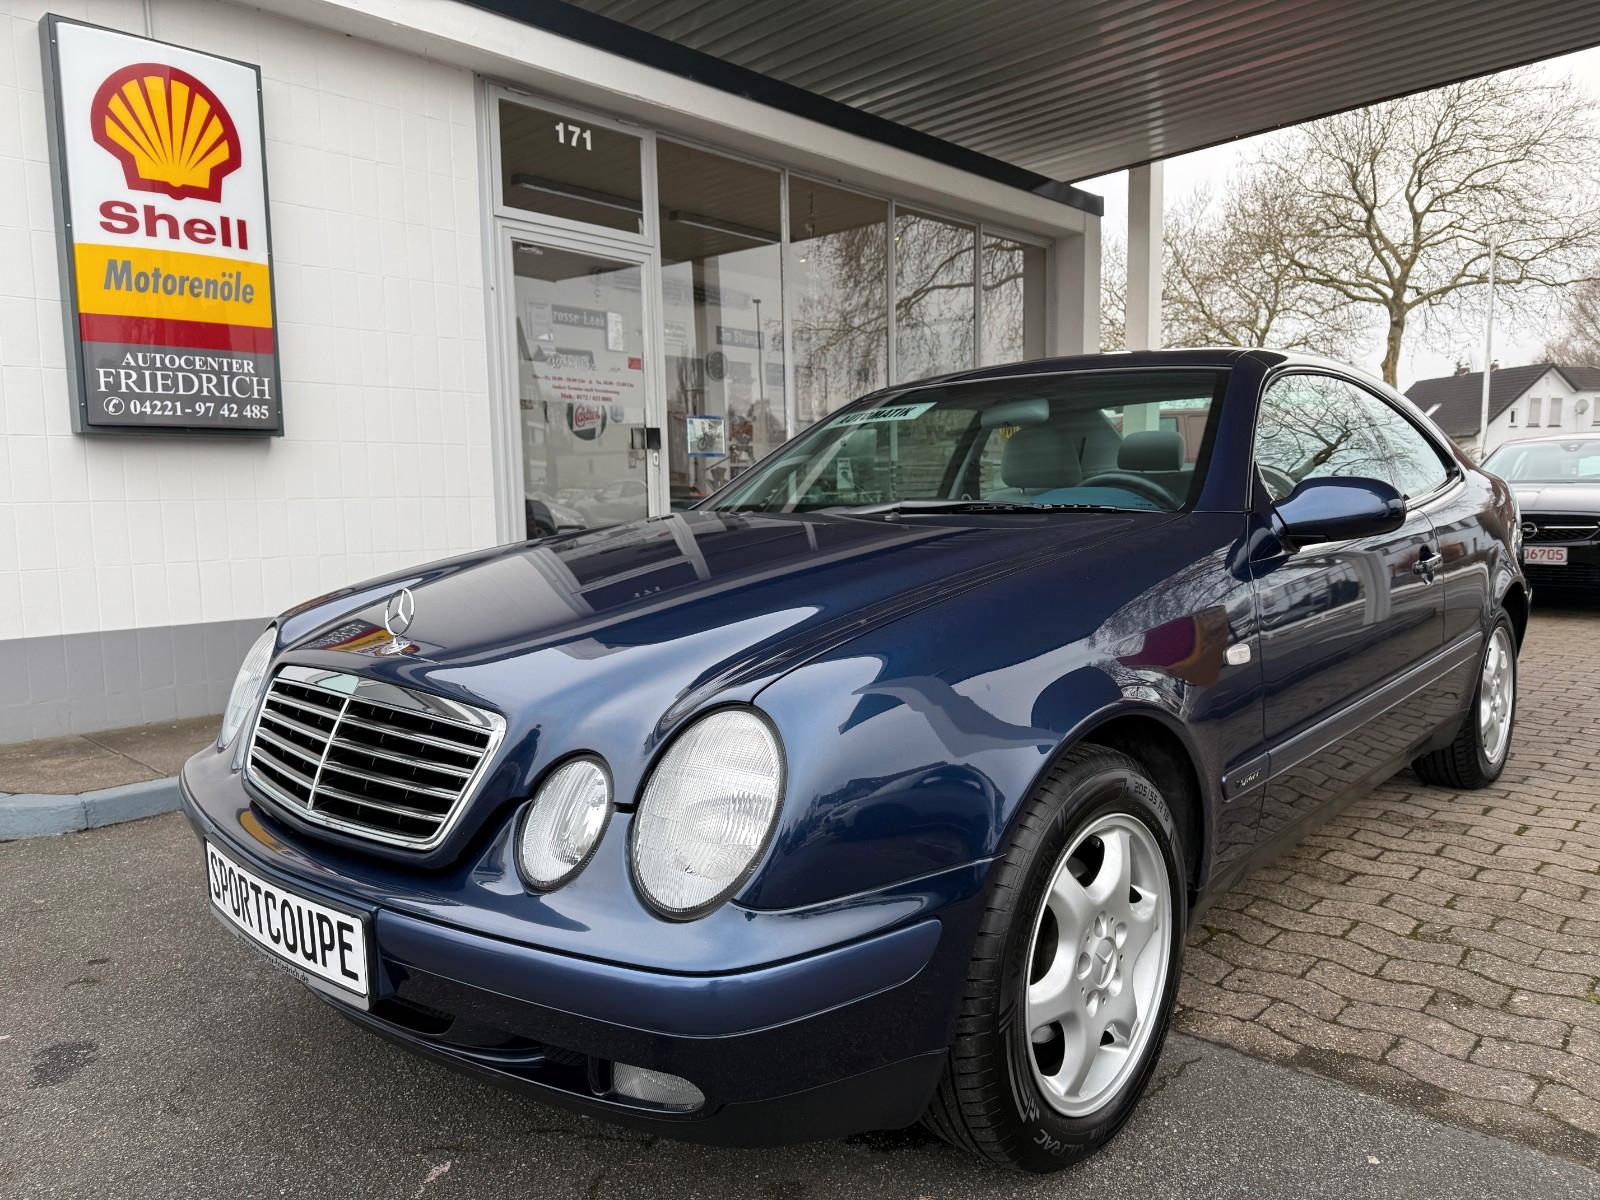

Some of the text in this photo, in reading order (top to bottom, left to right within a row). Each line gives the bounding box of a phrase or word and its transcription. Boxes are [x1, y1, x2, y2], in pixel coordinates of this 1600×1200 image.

[555, 122, 592, 151] 171
[99, 200, 248, 250] Shell
[104, 259, 254, 304] Motorenöle
[122, 352, 255, 374] AUTOCENTER
[96, 368, 271, 399] FRIEDRICH
[220, 403, 239, 418] 42
[243, 404, 269, 419] 485
[838, 406, 917, 424] AUTOMATIK
[1134, 781, 1158, 806] 205/55
[210, 851, 359, 982] SPORTCOUPE
